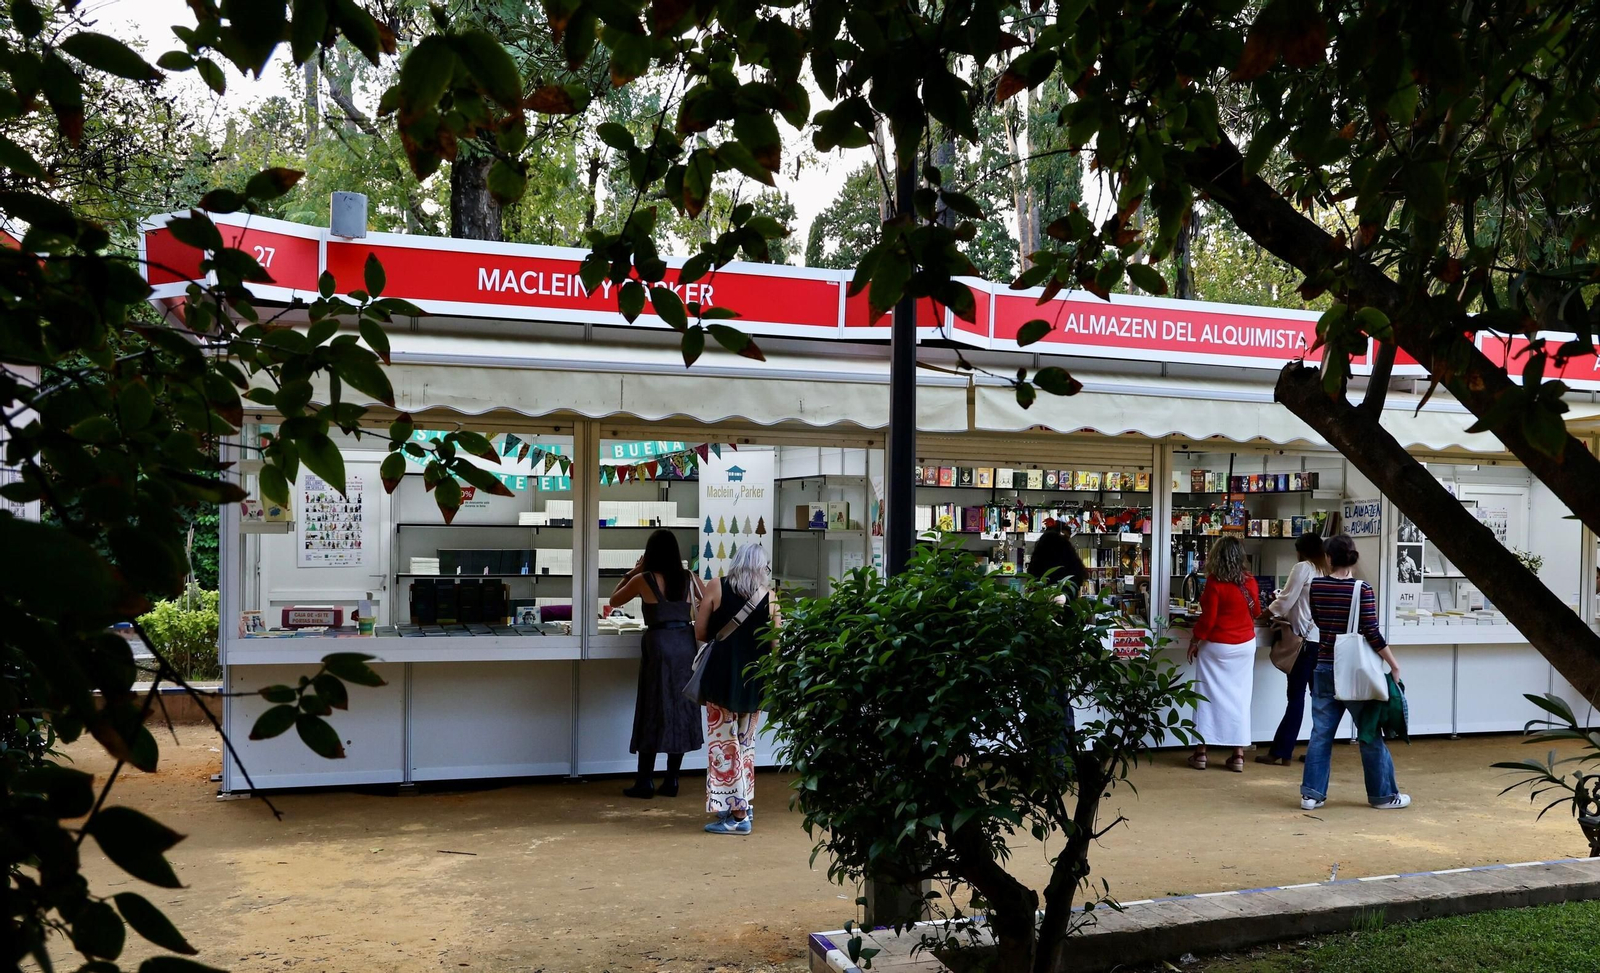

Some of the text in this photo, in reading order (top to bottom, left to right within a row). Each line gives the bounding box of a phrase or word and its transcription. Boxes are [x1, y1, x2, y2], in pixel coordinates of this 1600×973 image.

[254, 245, 276, 268] 27
[477, 267, 714, 306] MACLEIN Y AKER
[1064, 312, 1308, 350] ALMAZEN DEL ALQUIMISTA
[614, 441, 683, 458] BUENA
[706, 485, 764, 506] Maclein y Parker
[1400, 593, 1414, 601] ATH
